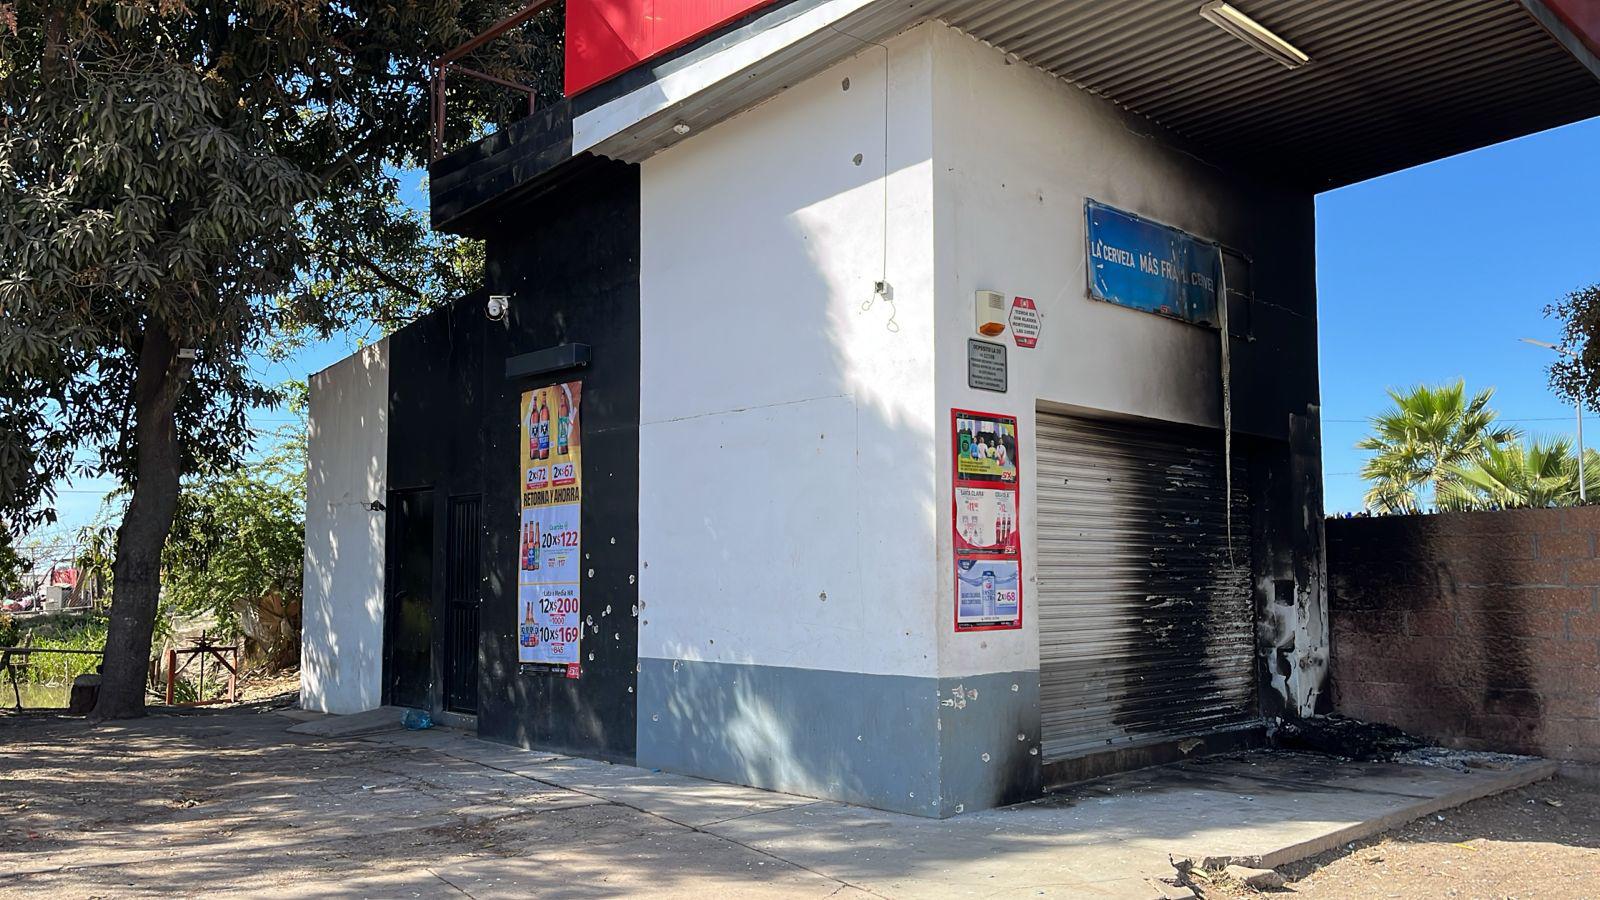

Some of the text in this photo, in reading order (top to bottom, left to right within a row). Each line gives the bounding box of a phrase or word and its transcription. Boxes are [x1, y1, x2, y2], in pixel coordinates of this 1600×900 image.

[1091, 241, 1102, 259] LA
[1103, 244, 1136, 269] CERVEZA
[1139, 252, 1159, 276] MÁS
[523, 490, 550, 507] RETORNA
[549, 489, 554, 504] Y
[554, 486, 580, 503] AHORRA
